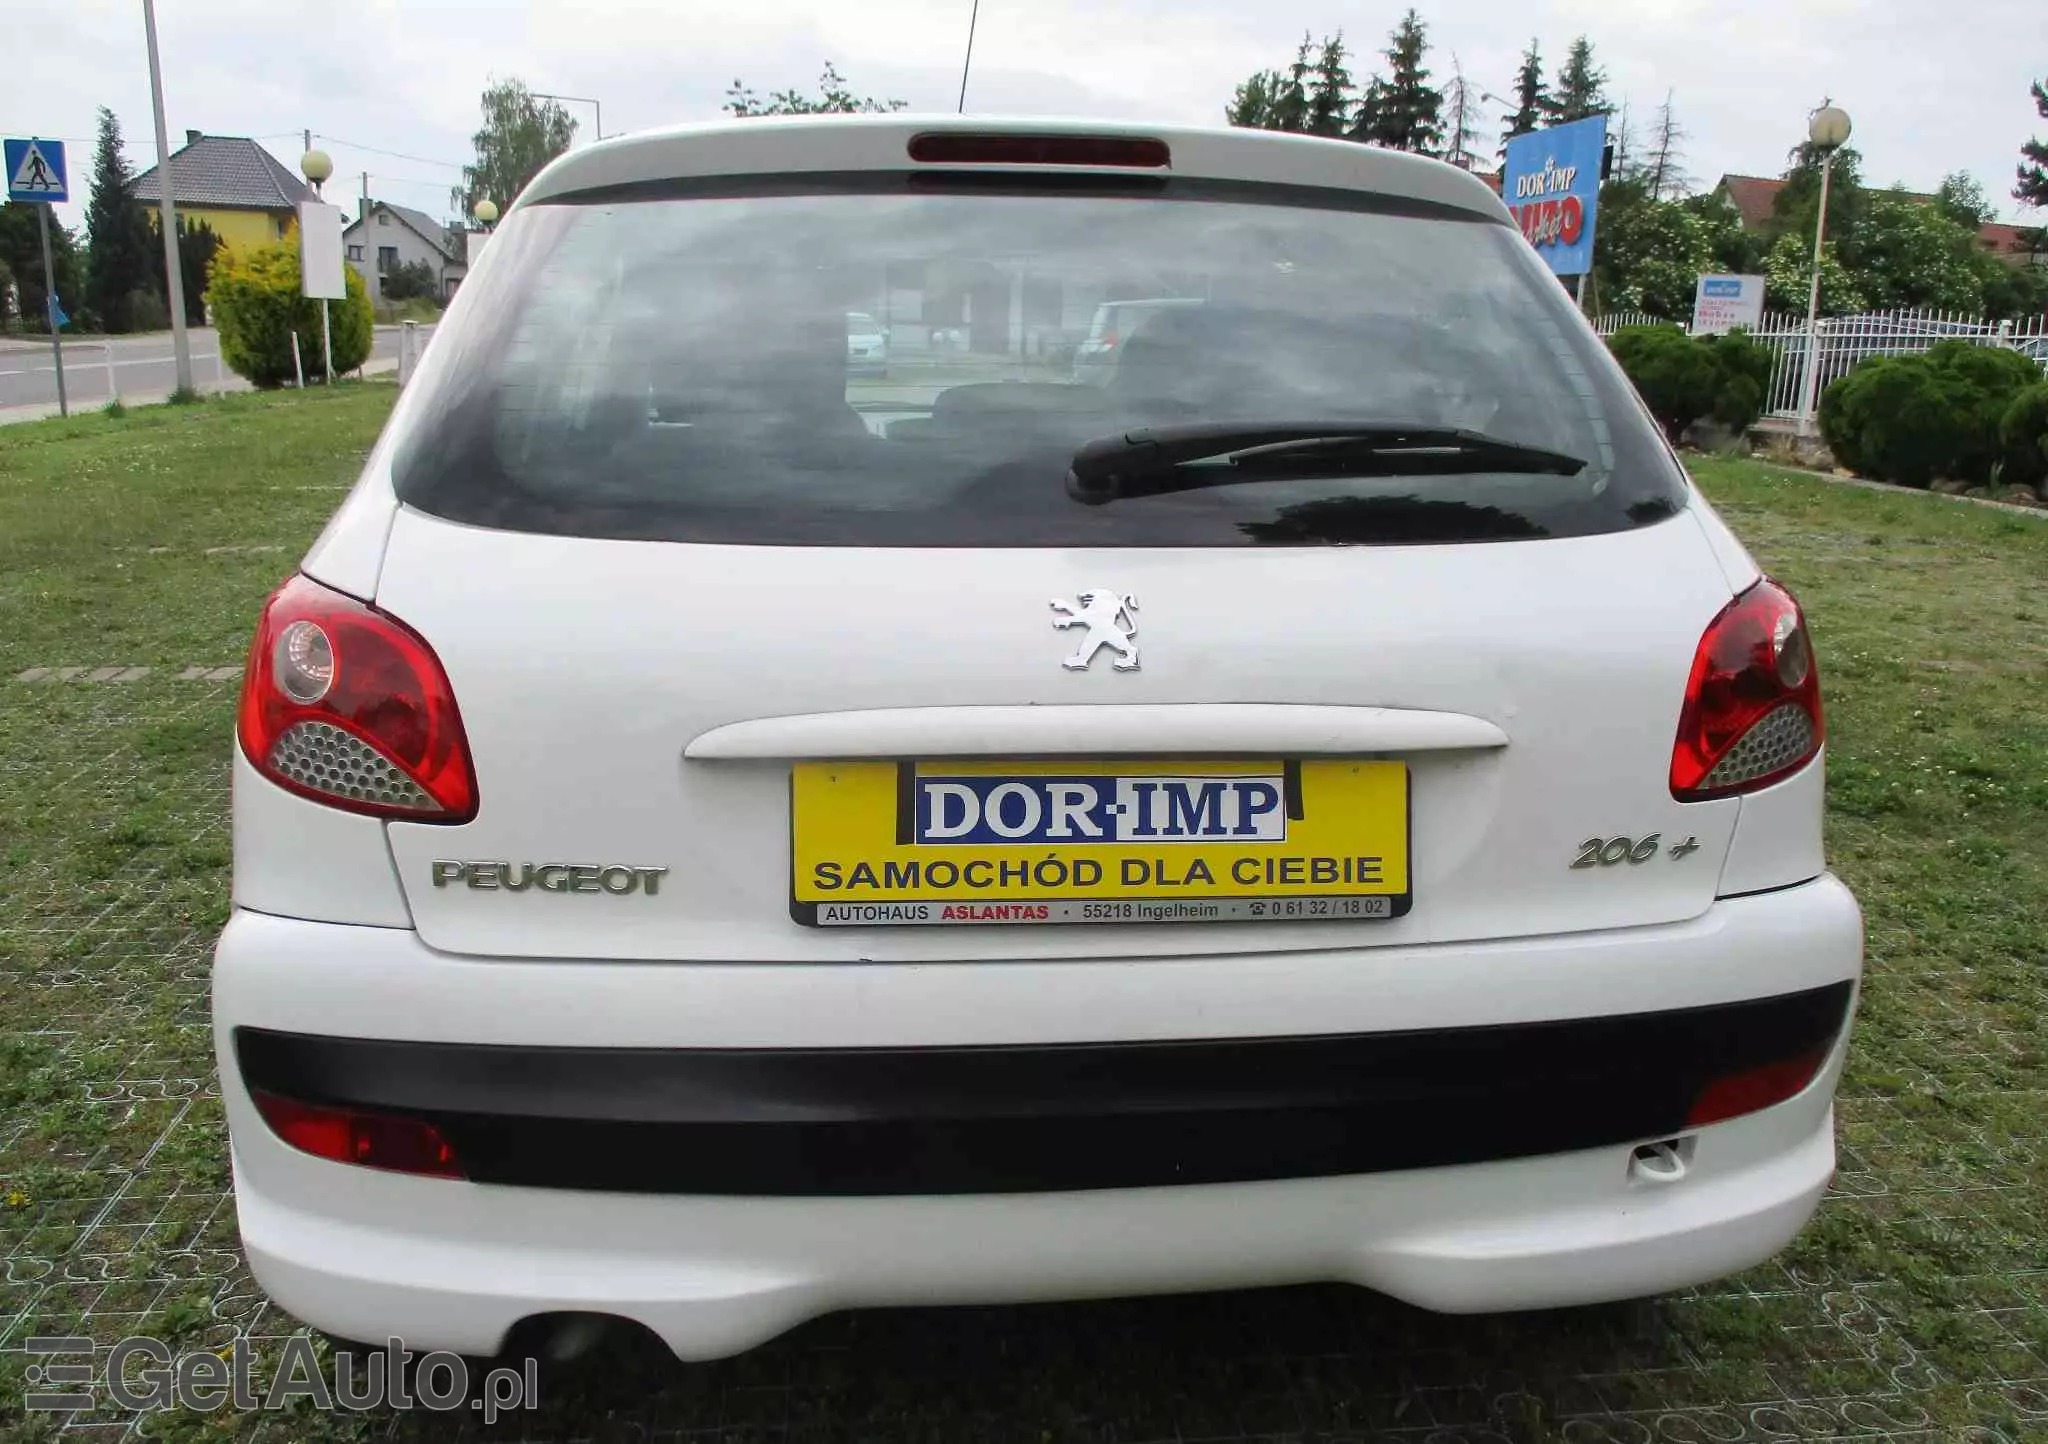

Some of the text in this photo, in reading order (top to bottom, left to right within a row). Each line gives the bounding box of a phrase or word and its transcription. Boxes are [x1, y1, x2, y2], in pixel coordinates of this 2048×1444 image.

[924, 781, 1279, 839] DOR-IMP
[1568, 832, 1662, 869] 206
[432, 858, 669, 895] PEUGEOT
[813, 853, 1384, 890] SAMOCHÓD DLA CIEBIE
[826, 905, 929, 921] AUTOHAUS
[941, 905, 1049, 920] ASLANTAS
[1083, 904, 1132, 918] 55218
[1137, 902, 1219, 920] Ingelheim
